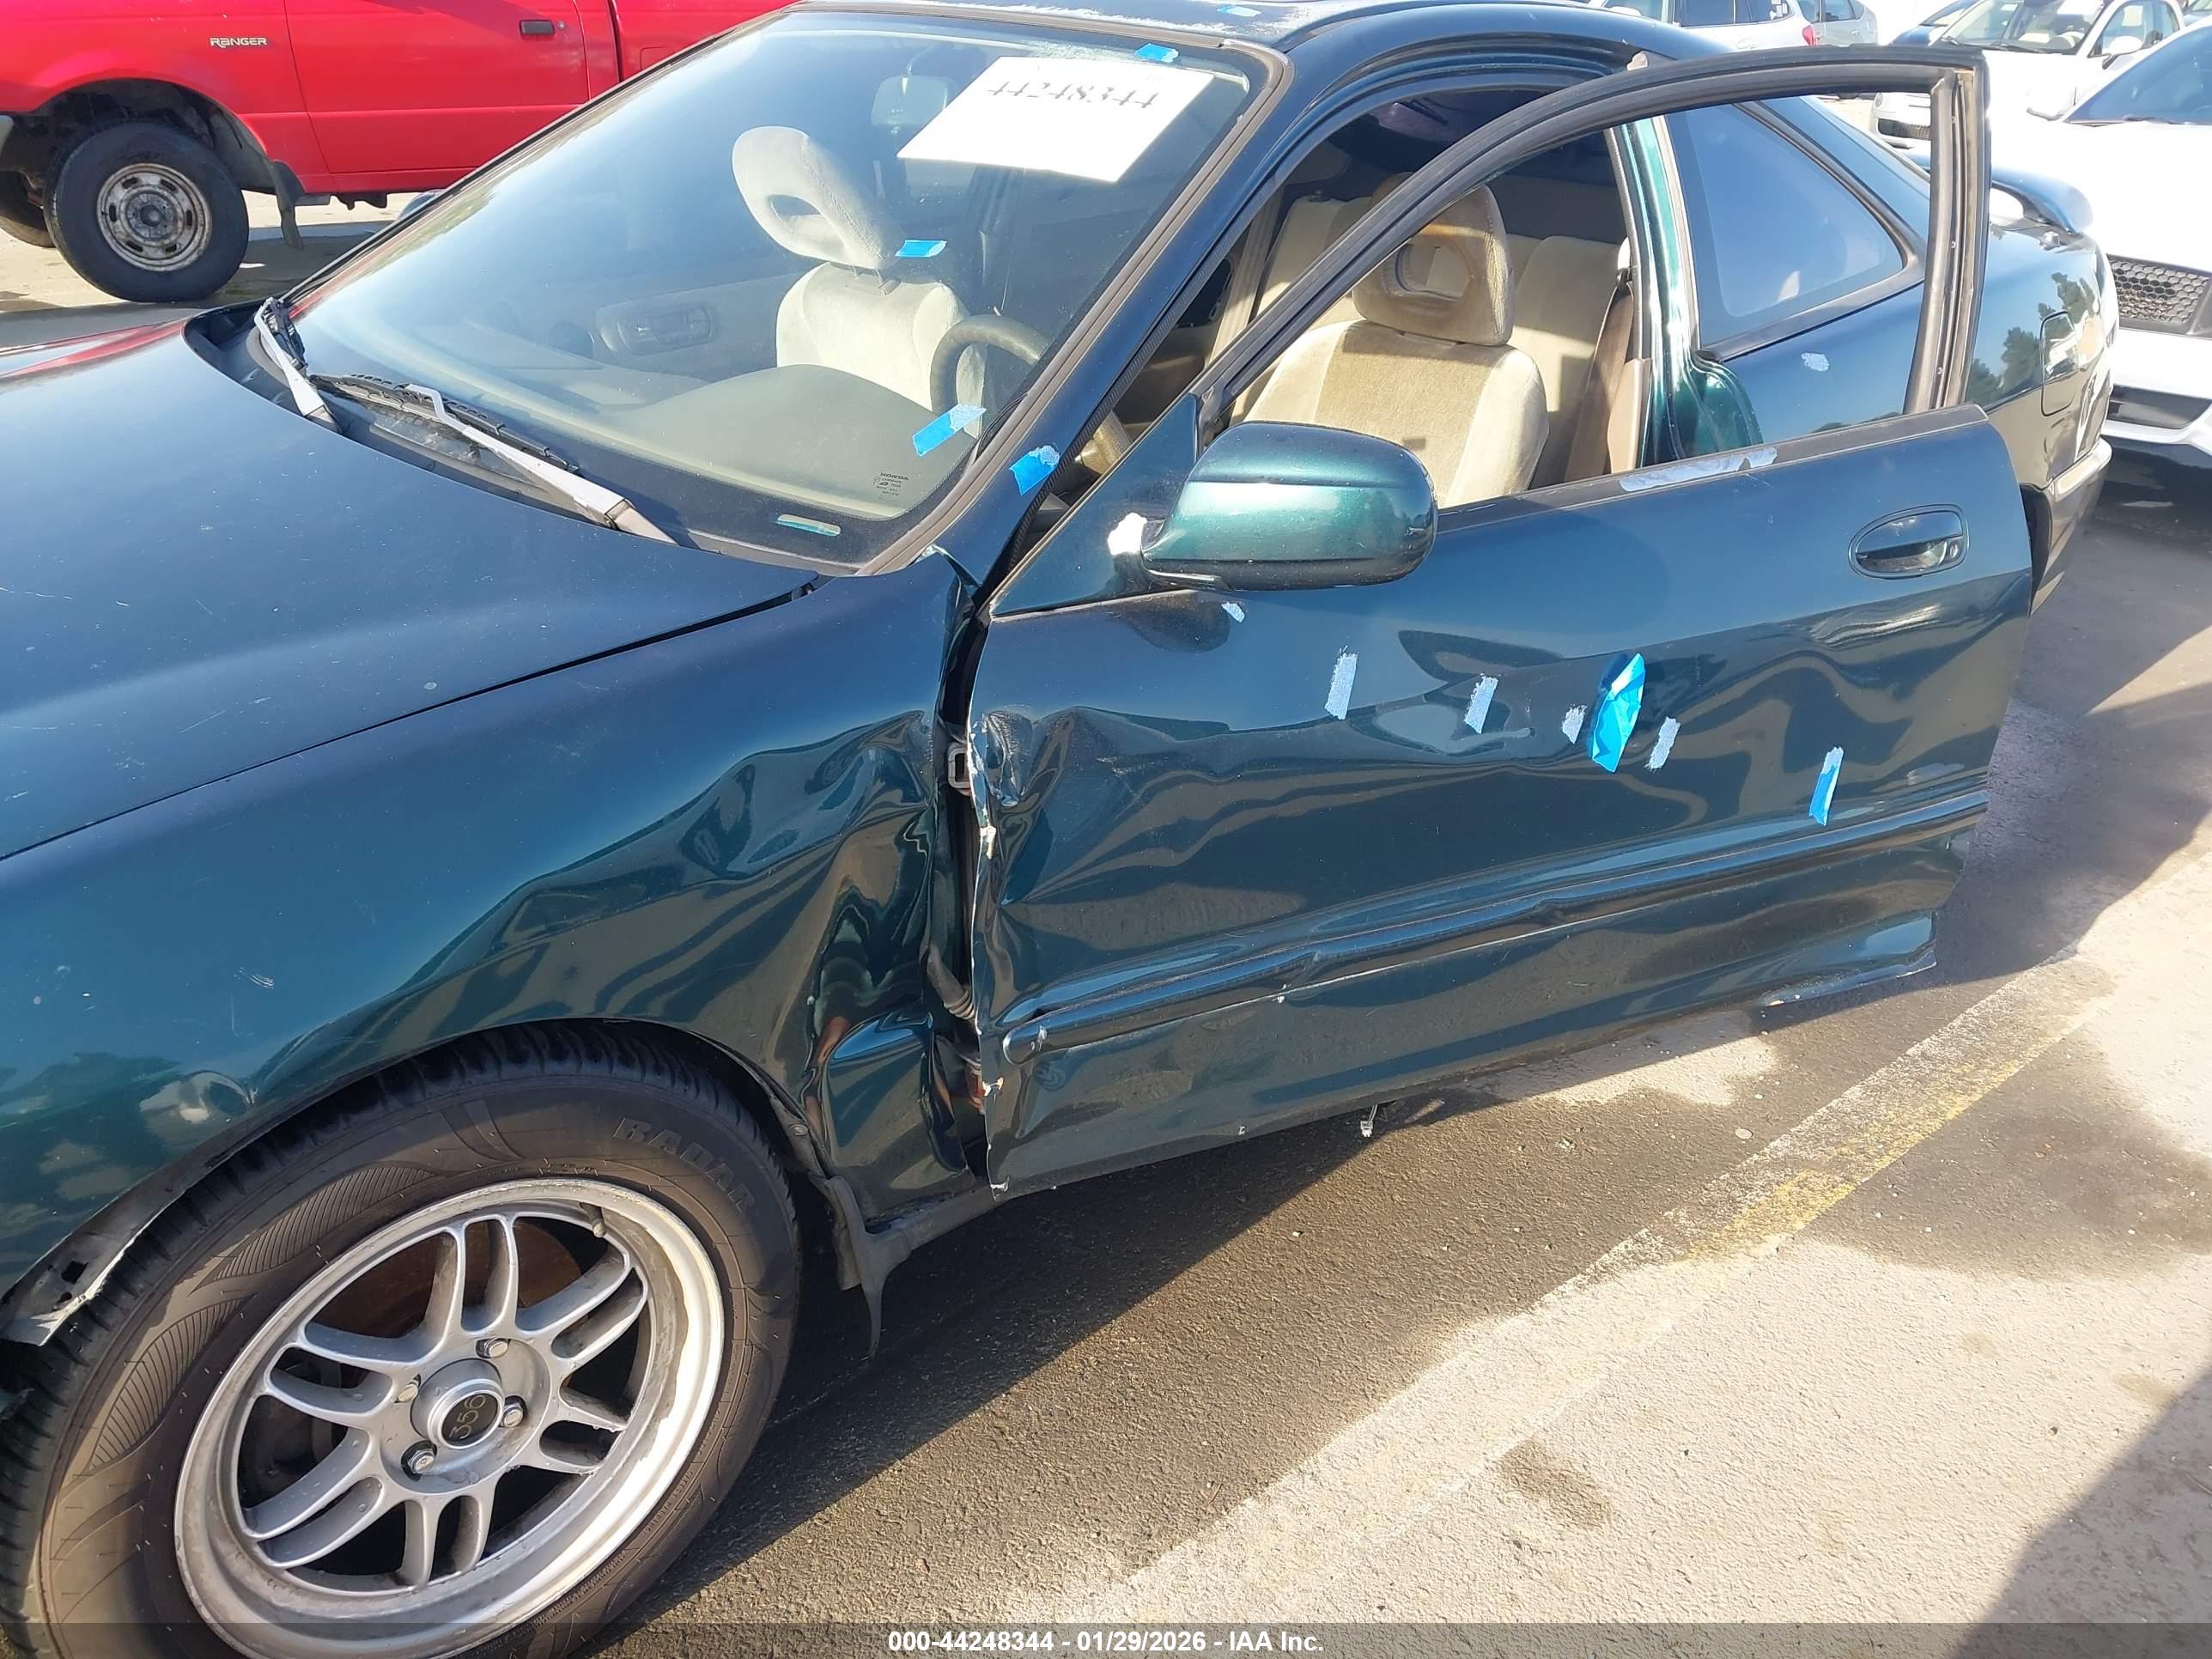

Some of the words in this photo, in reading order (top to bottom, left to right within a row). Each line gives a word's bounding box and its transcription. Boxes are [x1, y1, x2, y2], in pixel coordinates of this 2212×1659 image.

[210, 37, 267, 48] RANGER
[879, 472, 908, 481] HONDA
[612, 1117, 757, 1214] RADAR
